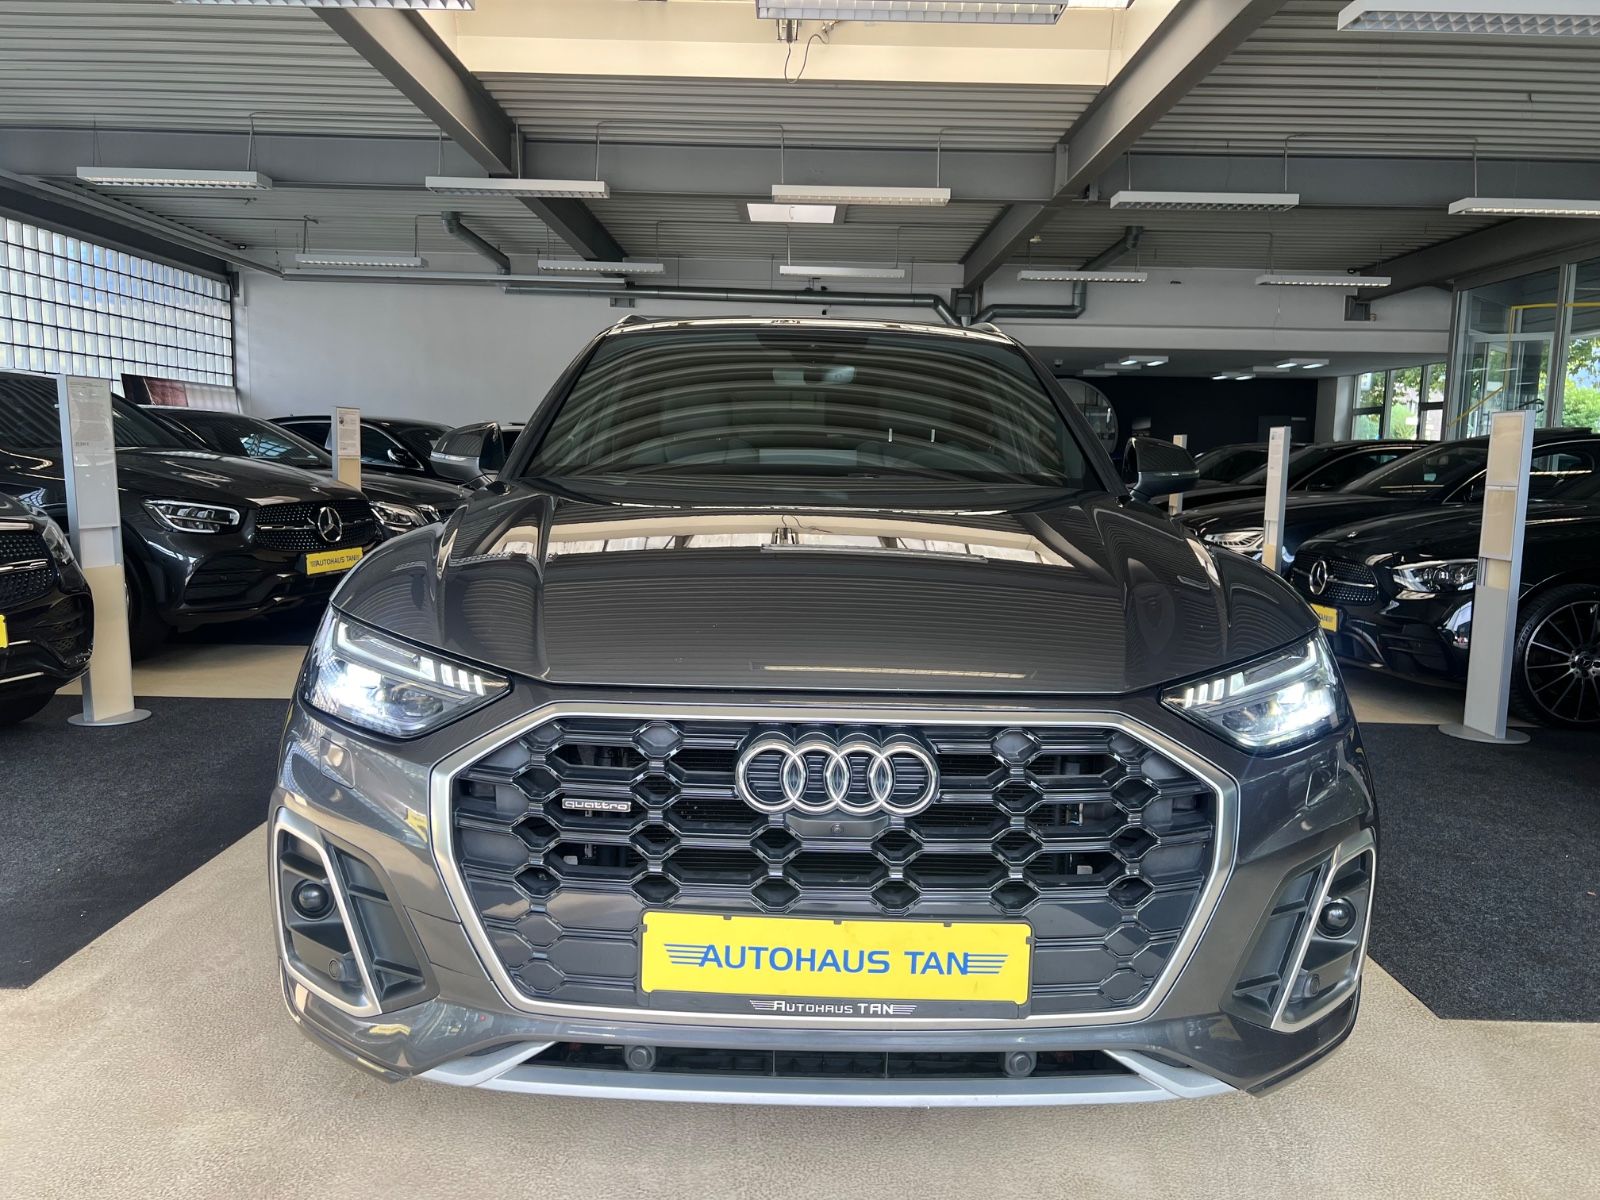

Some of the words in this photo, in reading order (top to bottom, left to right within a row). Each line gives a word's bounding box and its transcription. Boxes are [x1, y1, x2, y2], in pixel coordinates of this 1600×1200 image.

[315, 556, 345, 567] AUTOHAUS
[346, 554, 356, 562] TAN
[564, 800, 628, 811] quattro
[699, 944, 890, 974] AUTOHAUS
[904, 951, 969, 976] TAN
[773, 1000, 853, 1014] AUTOHAUS
[857, 1003, 894, 1015] TAN
